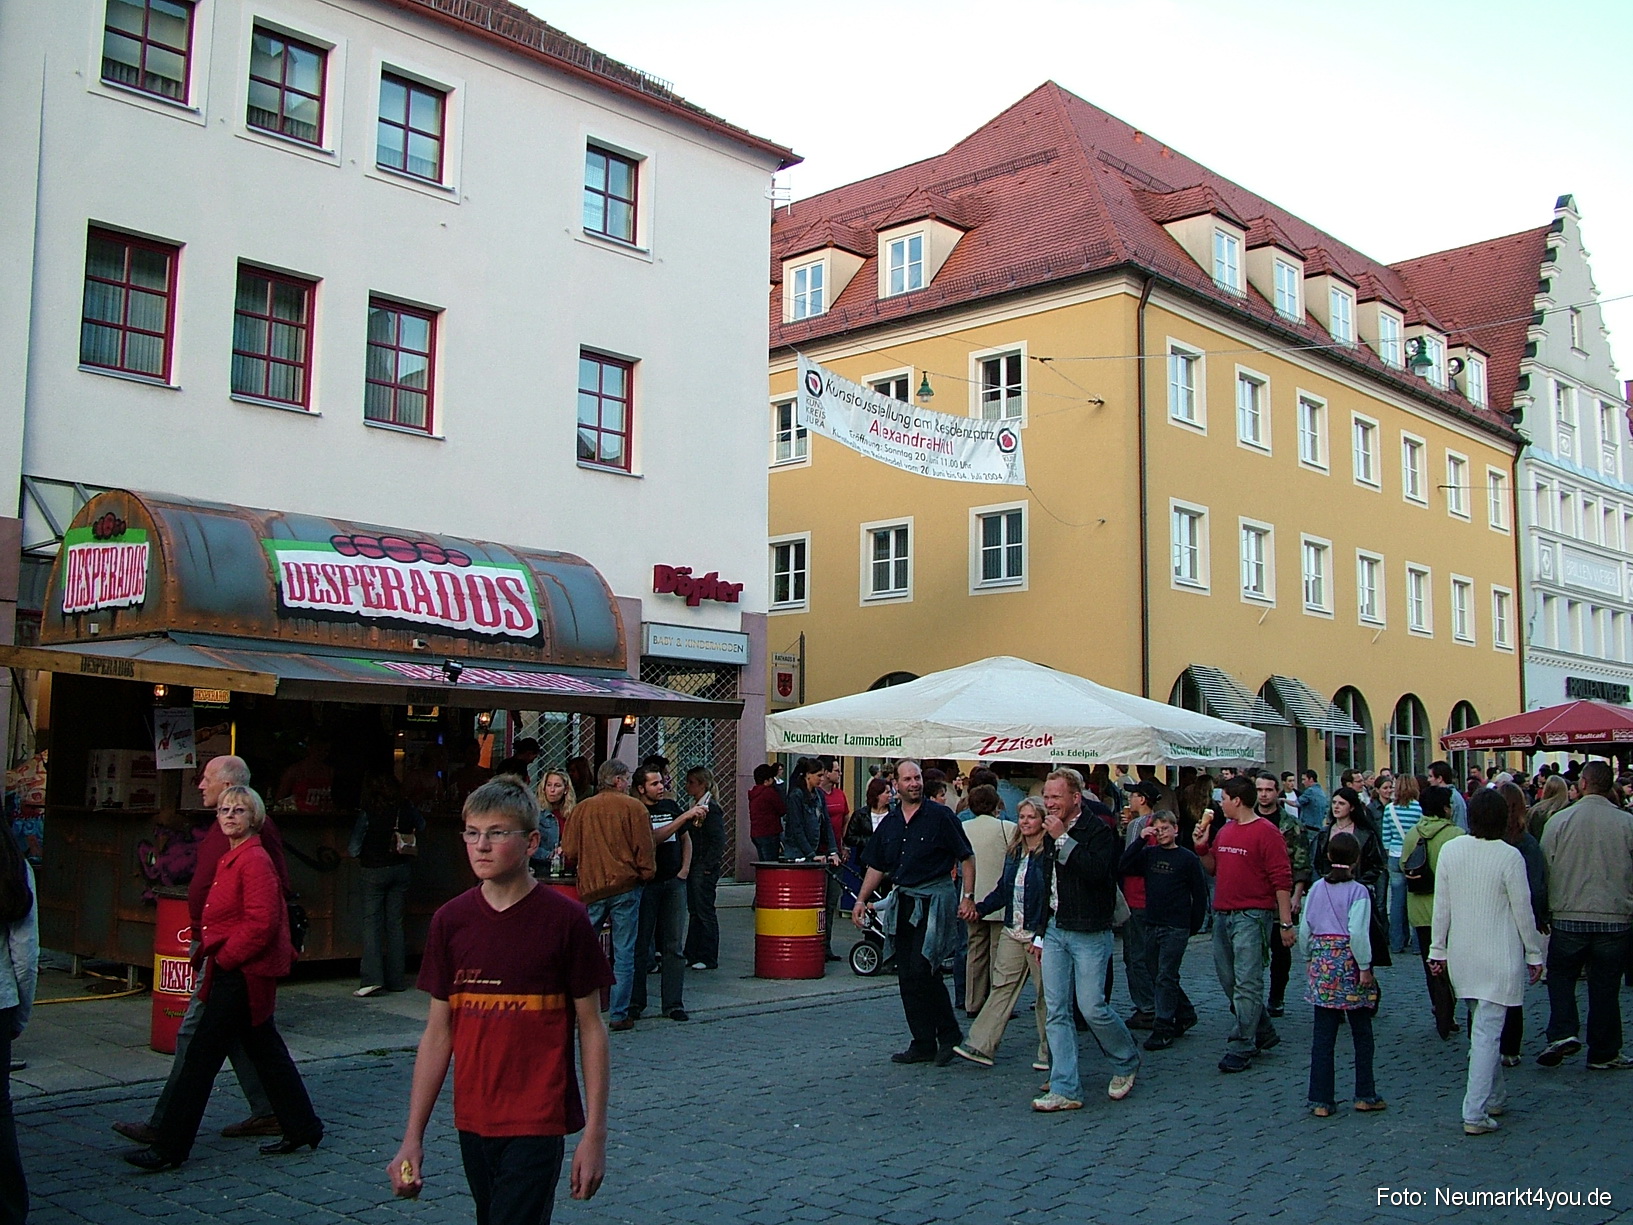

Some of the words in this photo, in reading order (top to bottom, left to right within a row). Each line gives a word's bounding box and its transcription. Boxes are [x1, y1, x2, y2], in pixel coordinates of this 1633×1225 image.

[806, 406, 826, 420] KREIS
[826, 378, 911, 429] Kunstausstellung
[914, 417, 932, 431] am
[806, 414, 825, 429] JURA
[884, 443, 913, 461] Sonntag
[65, 545, 148, 609] DESPERADOS
[282, 561, 535, 632] DESPERADOS
[653, 635, 674, 647] BABY
[676, 637, 682, 648] &
[80, 655, 135, 678] DESPERADOS
[783, 730, 839, 745] Neumarkter
[844, 733, 902, 748] Lammsbräu
[978, 733, 1053, 756] Zzzisch
[1050, 749, 1064, 758] das
[1067, 749, 1099, 759] Edelpils
[1169, 742, 1212, 757] Neumarkter
[1215, 745, 1255, 758] Lammsbräu
